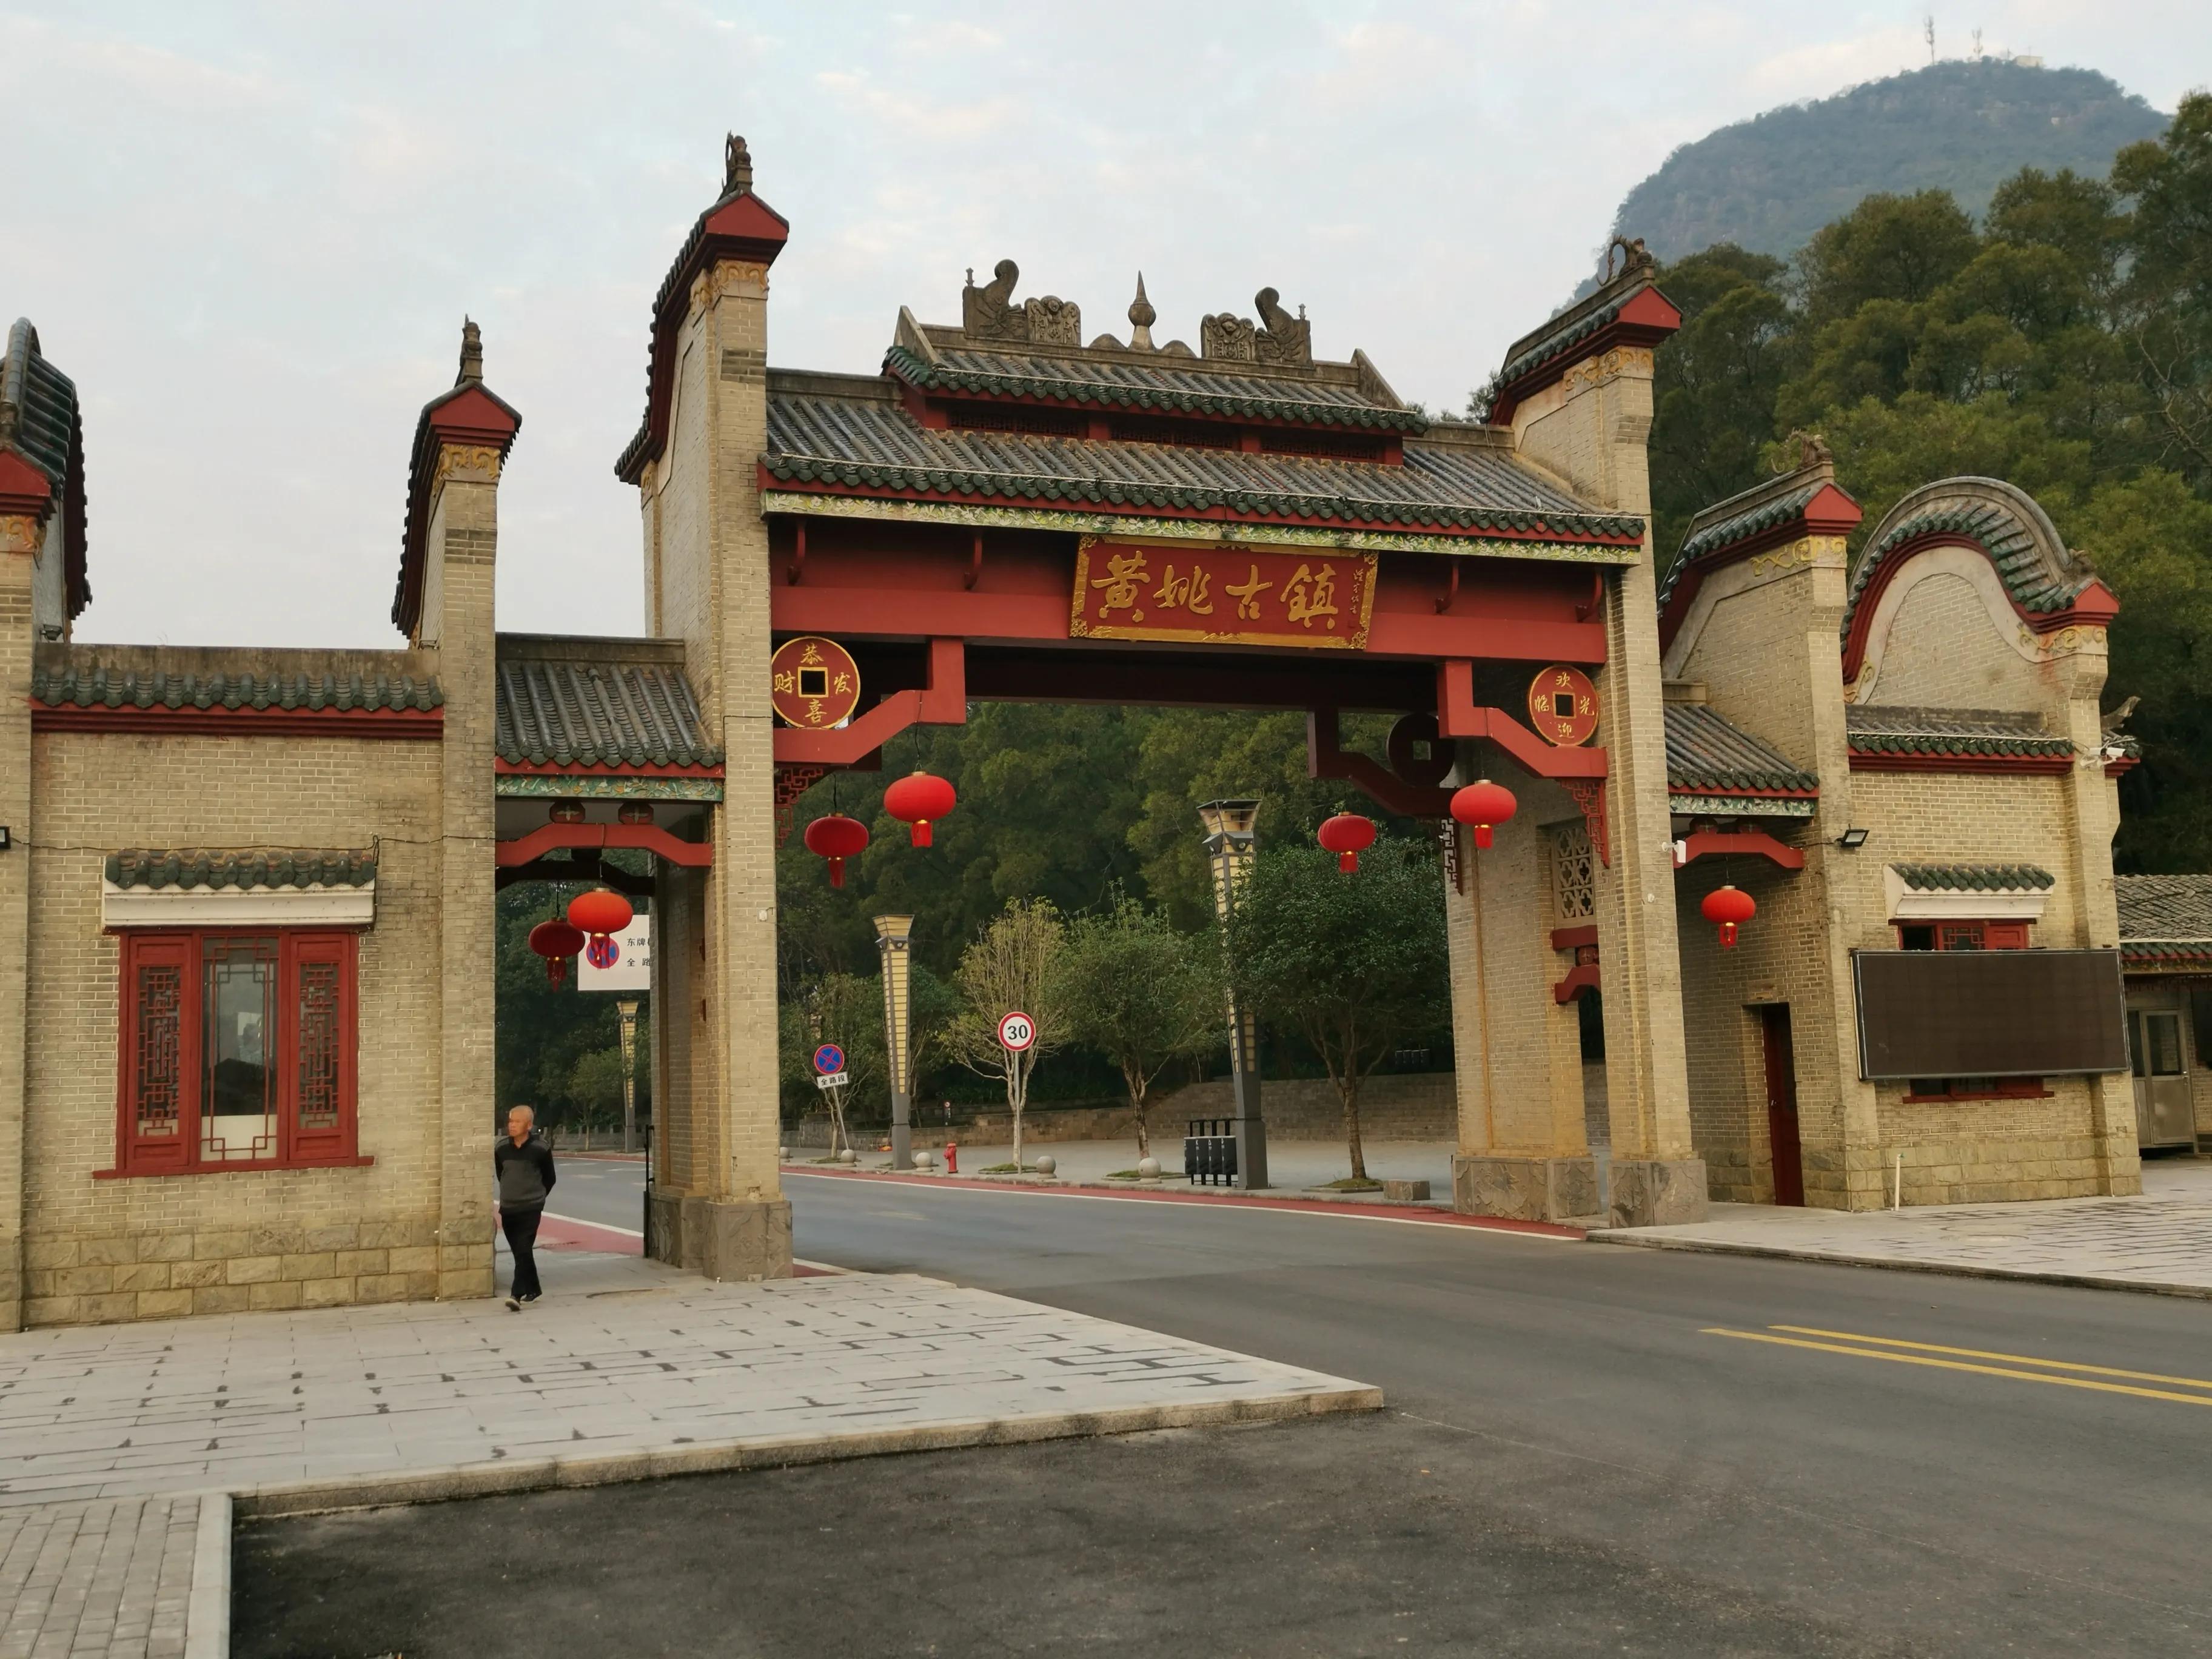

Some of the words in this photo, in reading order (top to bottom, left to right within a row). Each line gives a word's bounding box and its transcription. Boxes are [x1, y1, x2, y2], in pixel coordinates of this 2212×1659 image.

[800, 642, 824, 665] 恭
[774, 670, 796, 693] 财
[834, 672, 851, 694] 发
[1556, 671, 1574, 689] 欢
[805, 699, 827, 723] 喜
[1579, 695, 1595, 716] 光
[1558, 722, 1575, 739] 迎
[627, 937, 649, 947] 东牌
[1007, 1024, 1028, 1040] 30
[821, 1074, 845, 1086] 全路段
